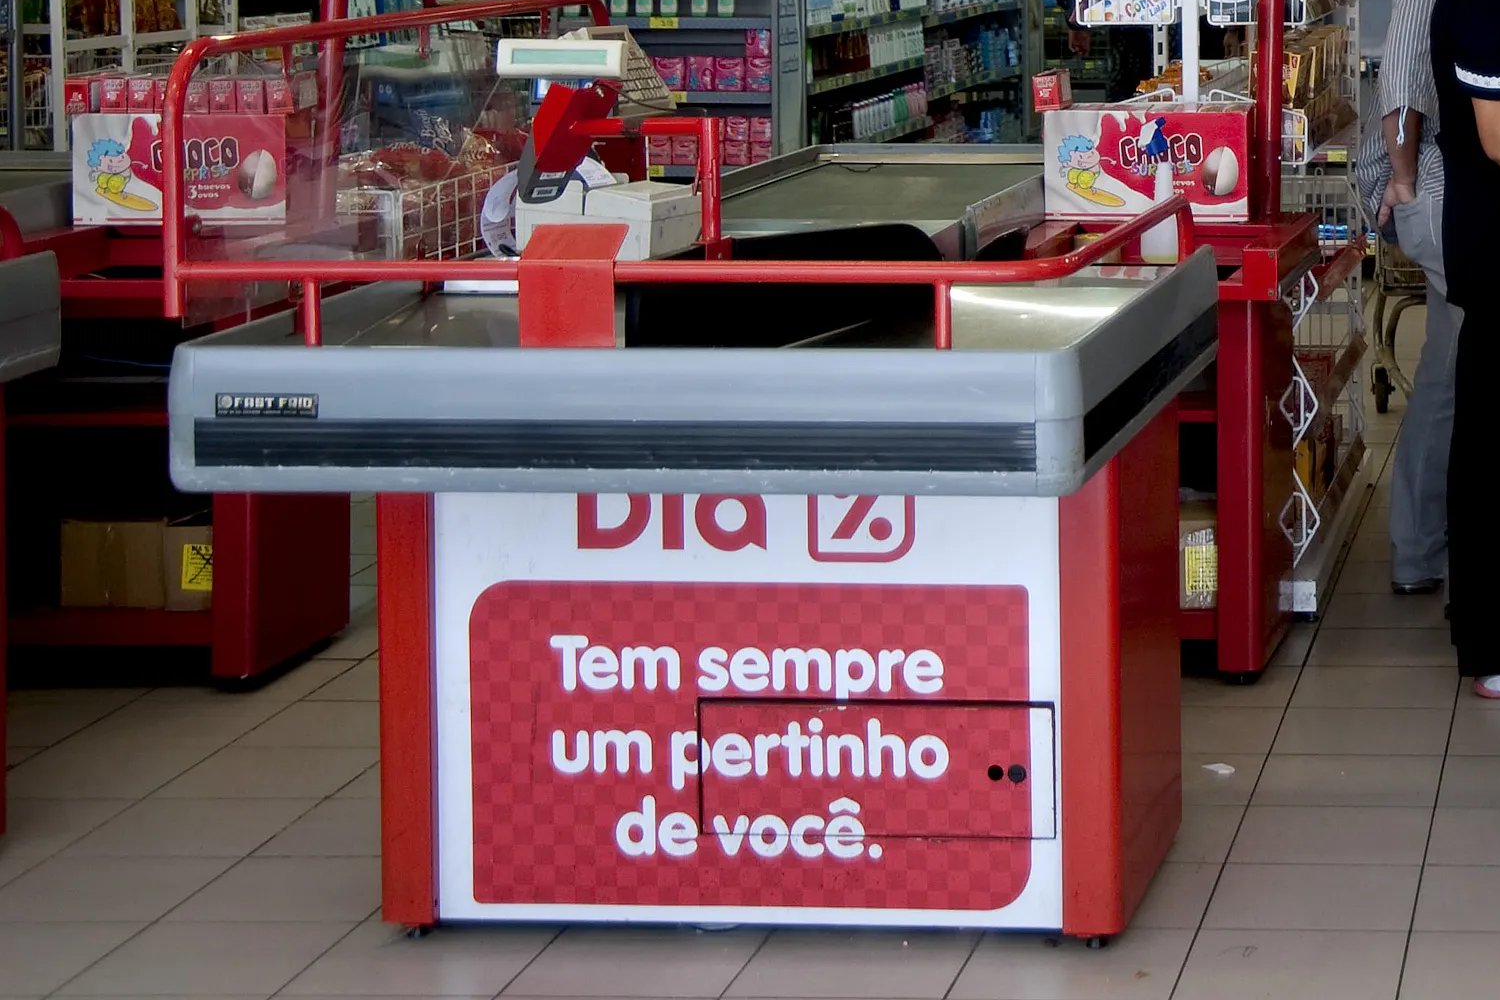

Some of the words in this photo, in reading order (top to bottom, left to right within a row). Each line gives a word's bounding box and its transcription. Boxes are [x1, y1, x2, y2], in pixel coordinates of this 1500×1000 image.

[548, 635, 680, 694] Tem
[698, 645, 944, 711] sempre
[551, 728, 652, 775] um
[671, 717, 949, 791] pertinho
[615, 796, 700, 858] de
[713, 796, 884, 859] você.
